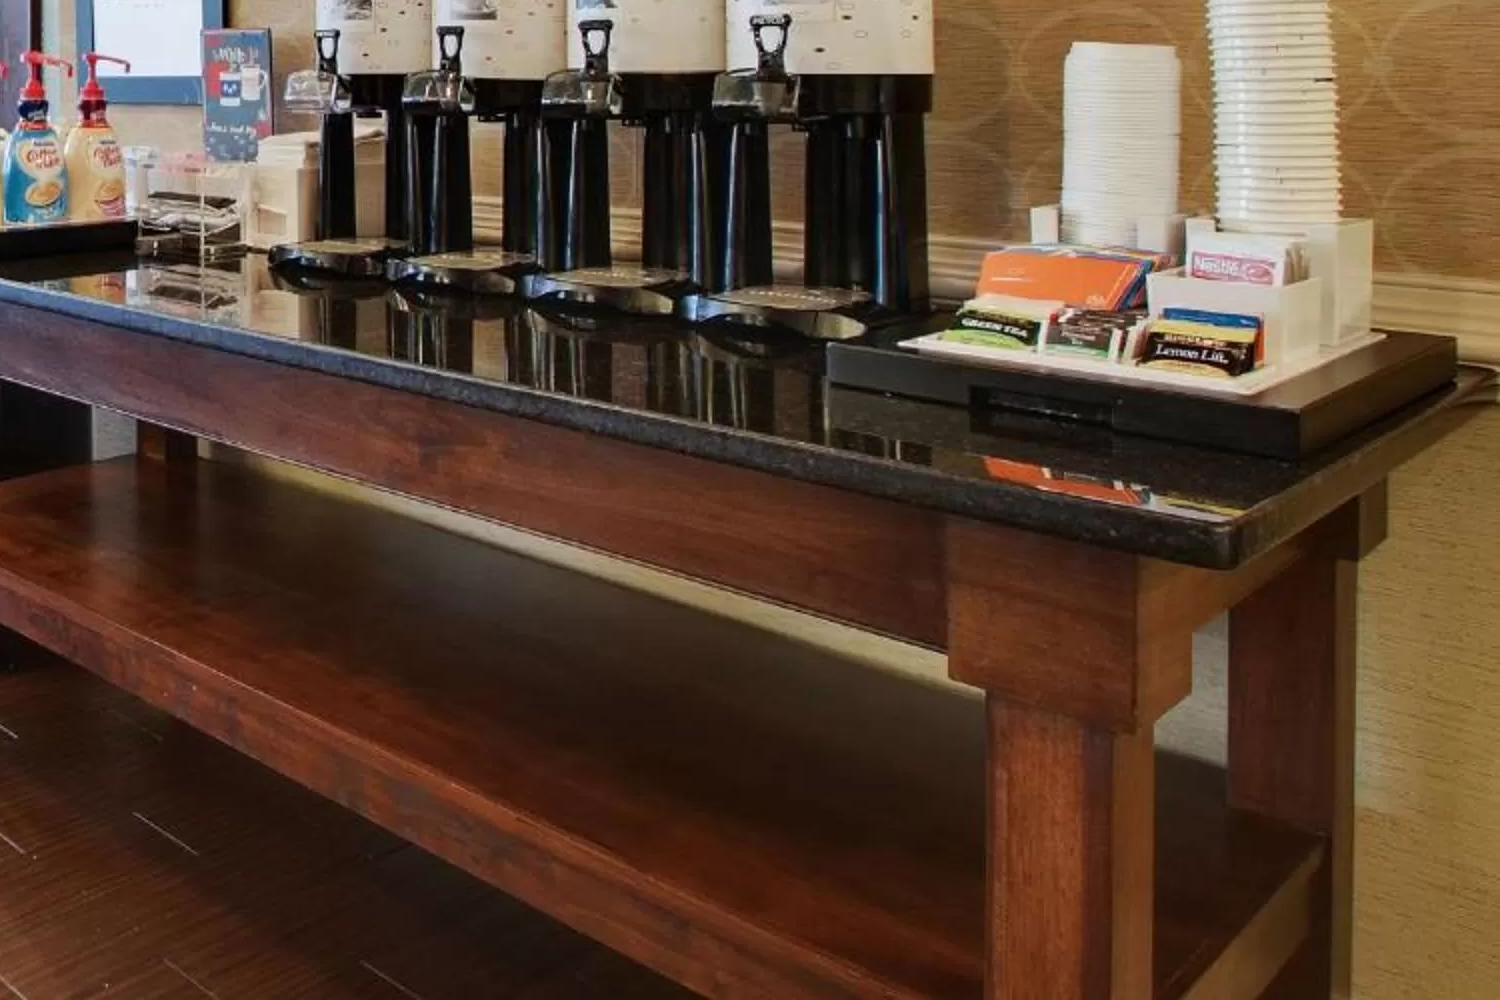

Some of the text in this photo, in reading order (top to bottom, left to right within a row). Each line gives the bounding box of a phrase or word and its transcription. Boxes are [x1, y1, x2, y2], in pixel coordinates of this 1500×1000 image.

[961, 317, 1003, 331] GREEN
[1002, 325, 1028, 339] TEA
[1155, 343, 1199, 359] Lemon
